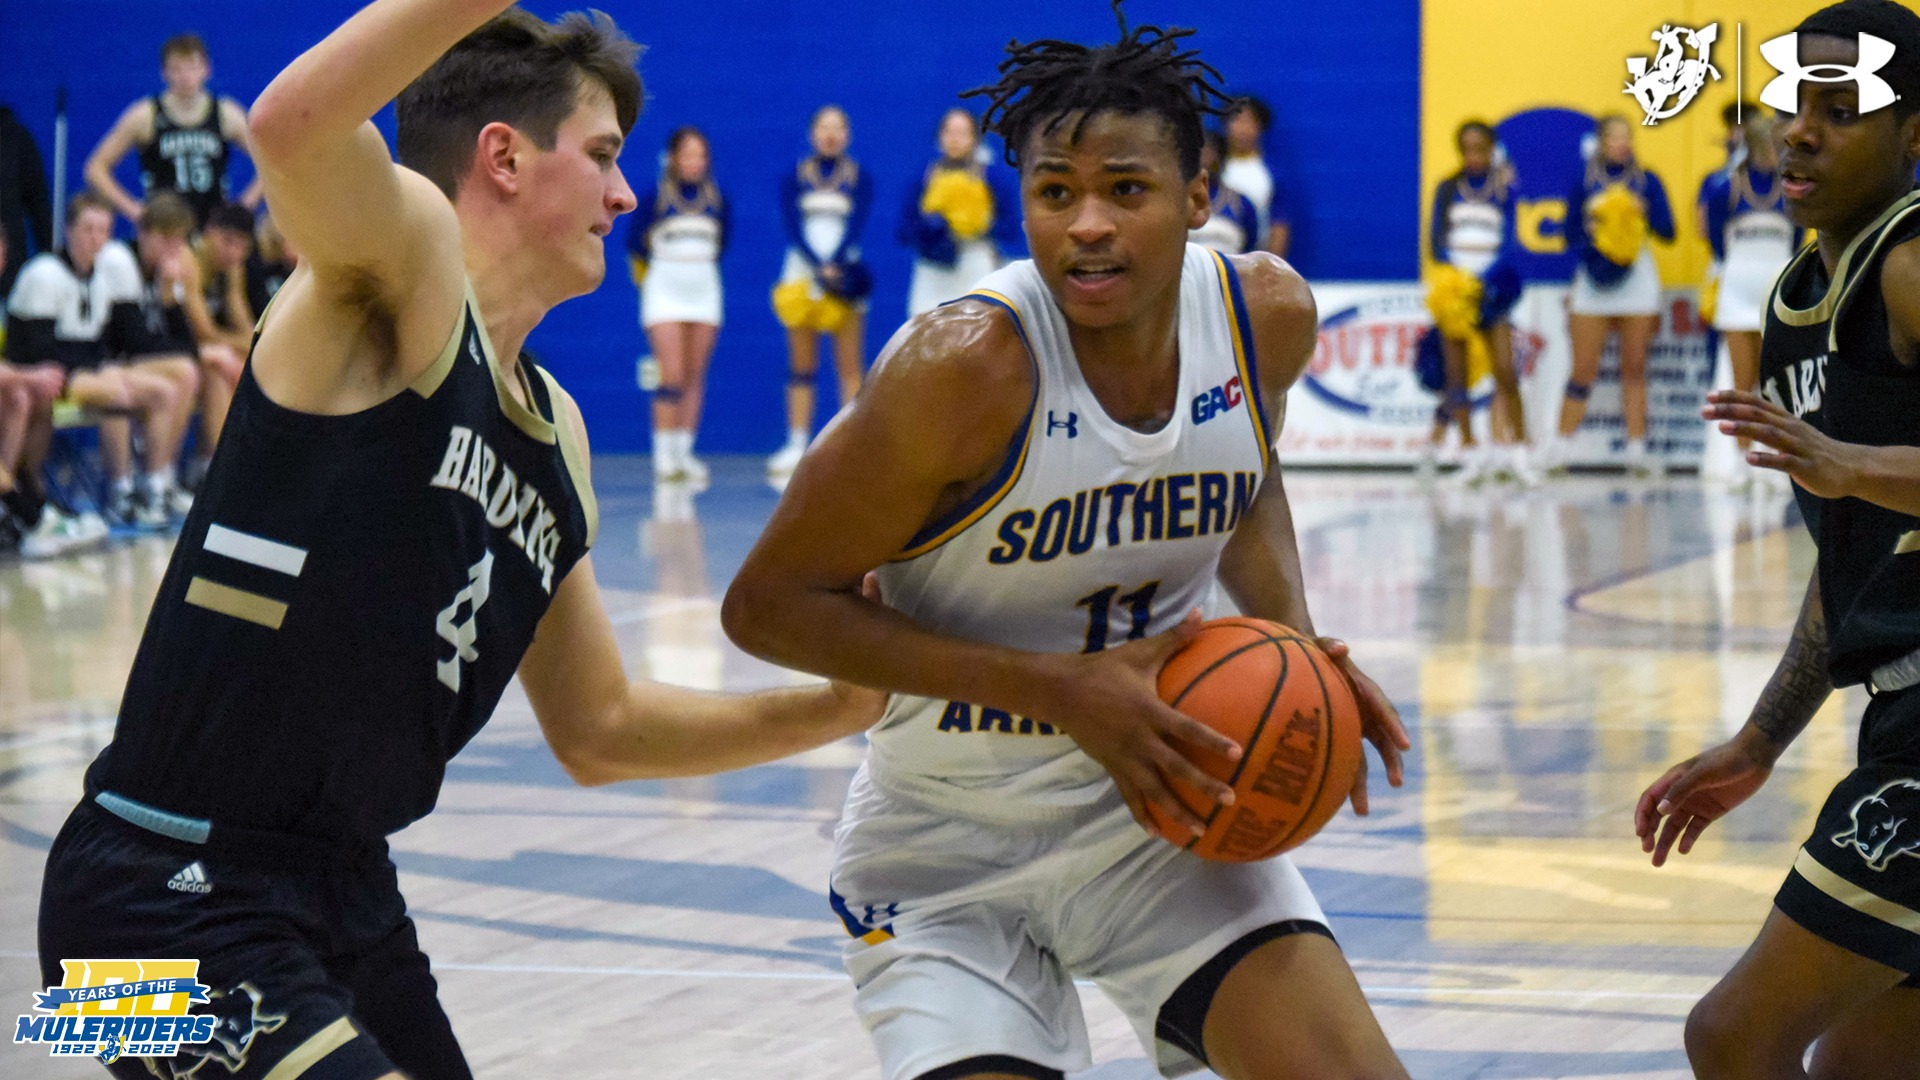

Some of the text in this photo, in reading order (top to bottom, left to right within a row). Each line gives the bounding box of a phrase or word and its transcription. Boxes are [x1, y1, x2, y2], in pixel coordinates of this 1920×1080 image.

[1191, 375, 1242, 426] GAC
[987, 471, 1257, 565] SOUTHERN
[1075, 579, 1161, 655] 11
[167, 879, 212, 894] adidas
